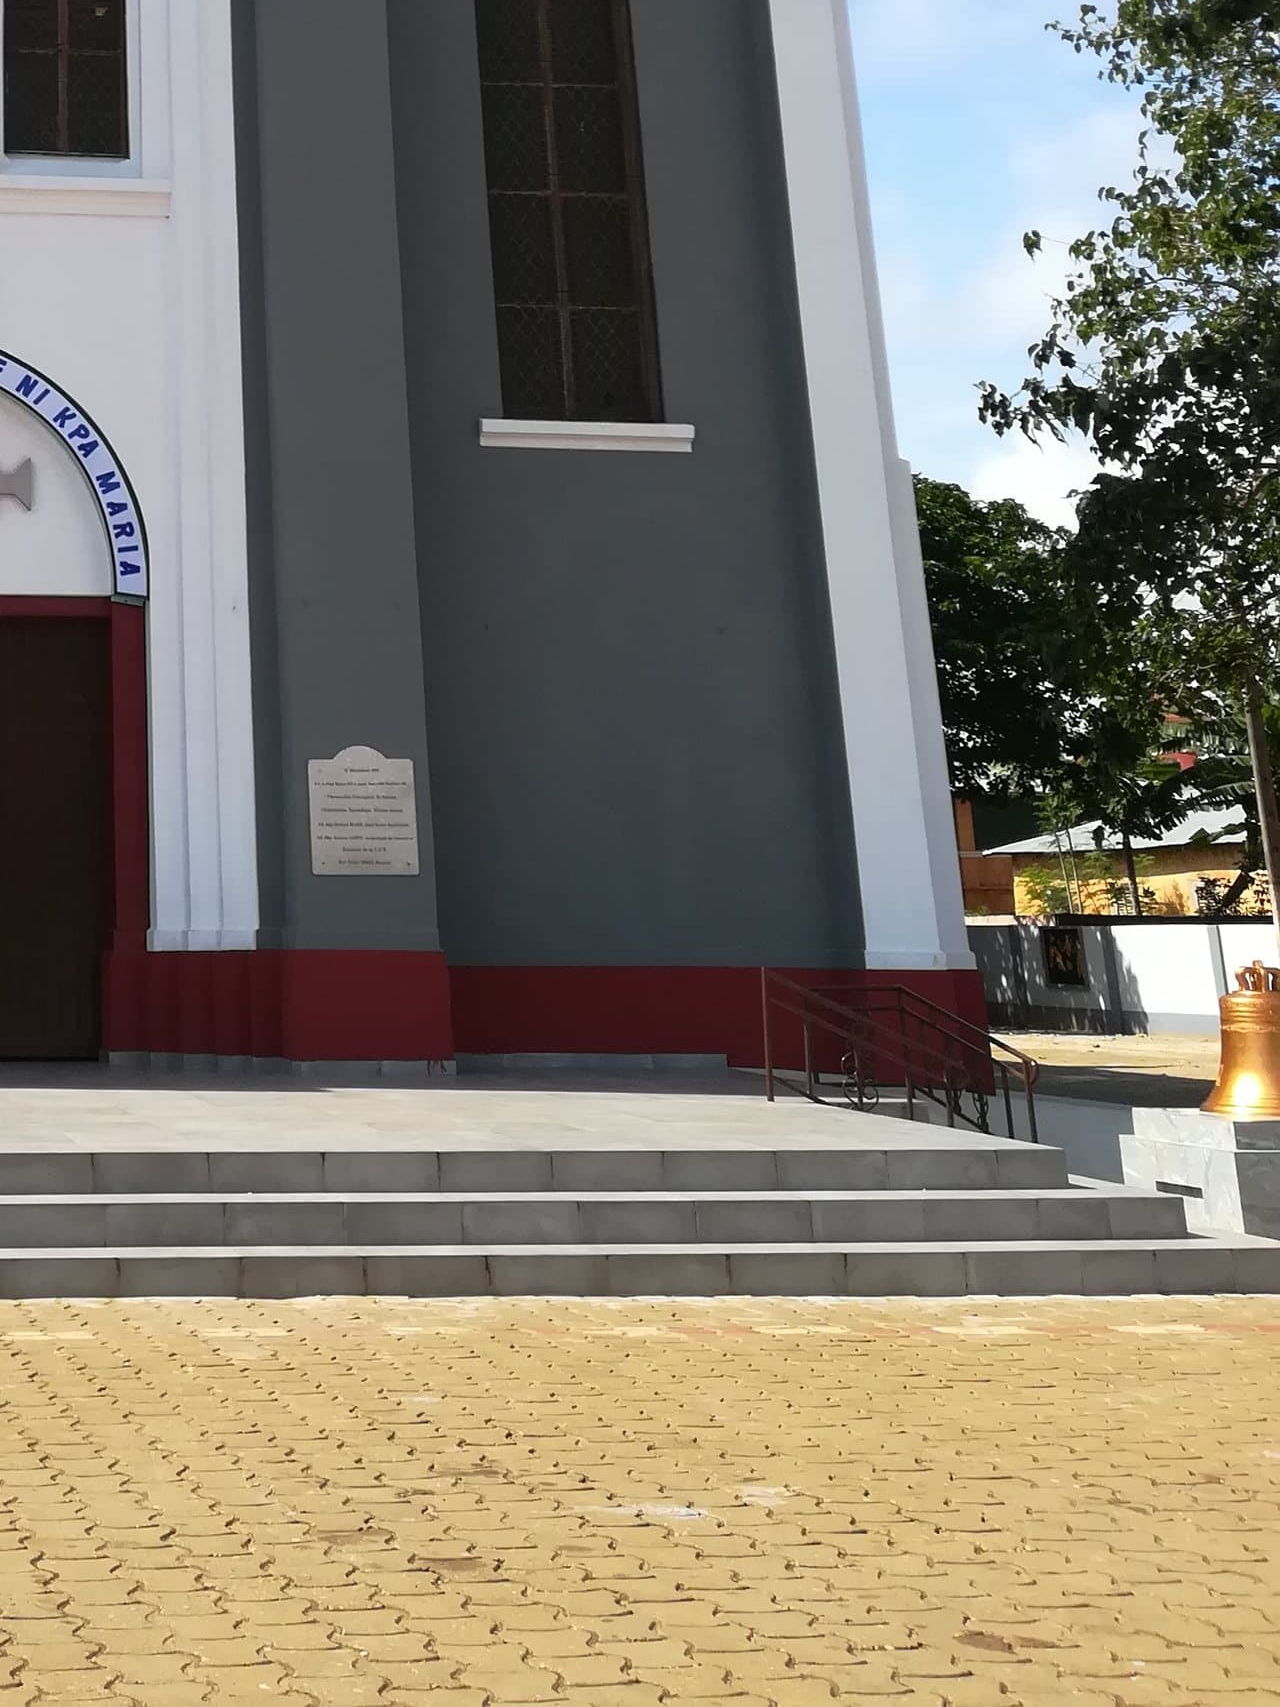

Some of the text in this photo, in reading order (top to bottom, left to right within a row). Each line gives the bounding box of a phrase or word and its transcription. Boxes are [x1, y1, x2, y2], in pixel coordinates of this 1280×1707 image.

[14, 374, 51, 406] NI
[52, 406, 100, 459] KPA
[95, 470, 141, 577] MARIA
